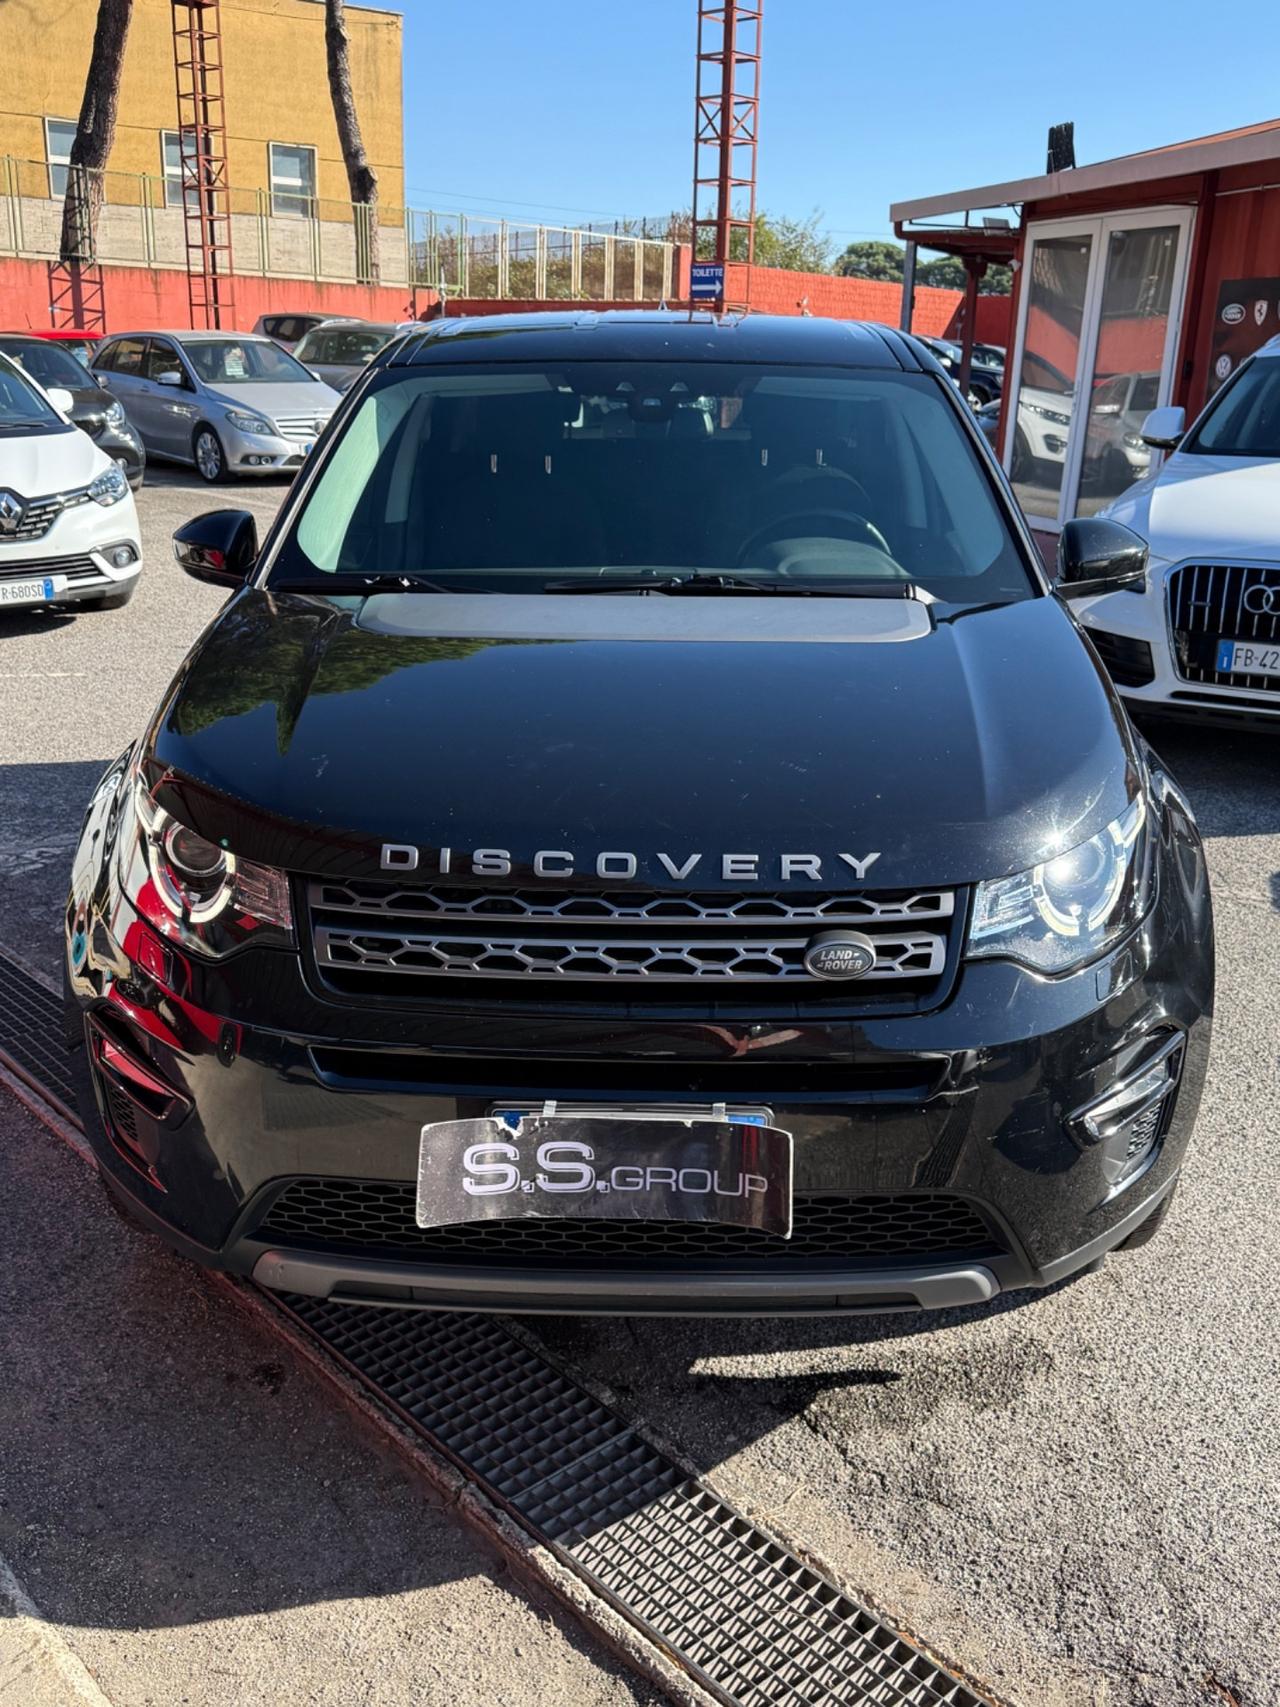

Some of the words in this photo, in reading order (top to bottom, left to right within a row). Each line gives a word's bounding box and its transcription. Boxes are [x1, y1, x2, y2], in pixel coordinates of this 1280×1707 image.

[692, 267, 723, 277] TOILETTE
[380, 843, 881, 881] DISCOVERY
[821, 950, 853, 960] LAND
[824, 960, 862, 970] ROVER
